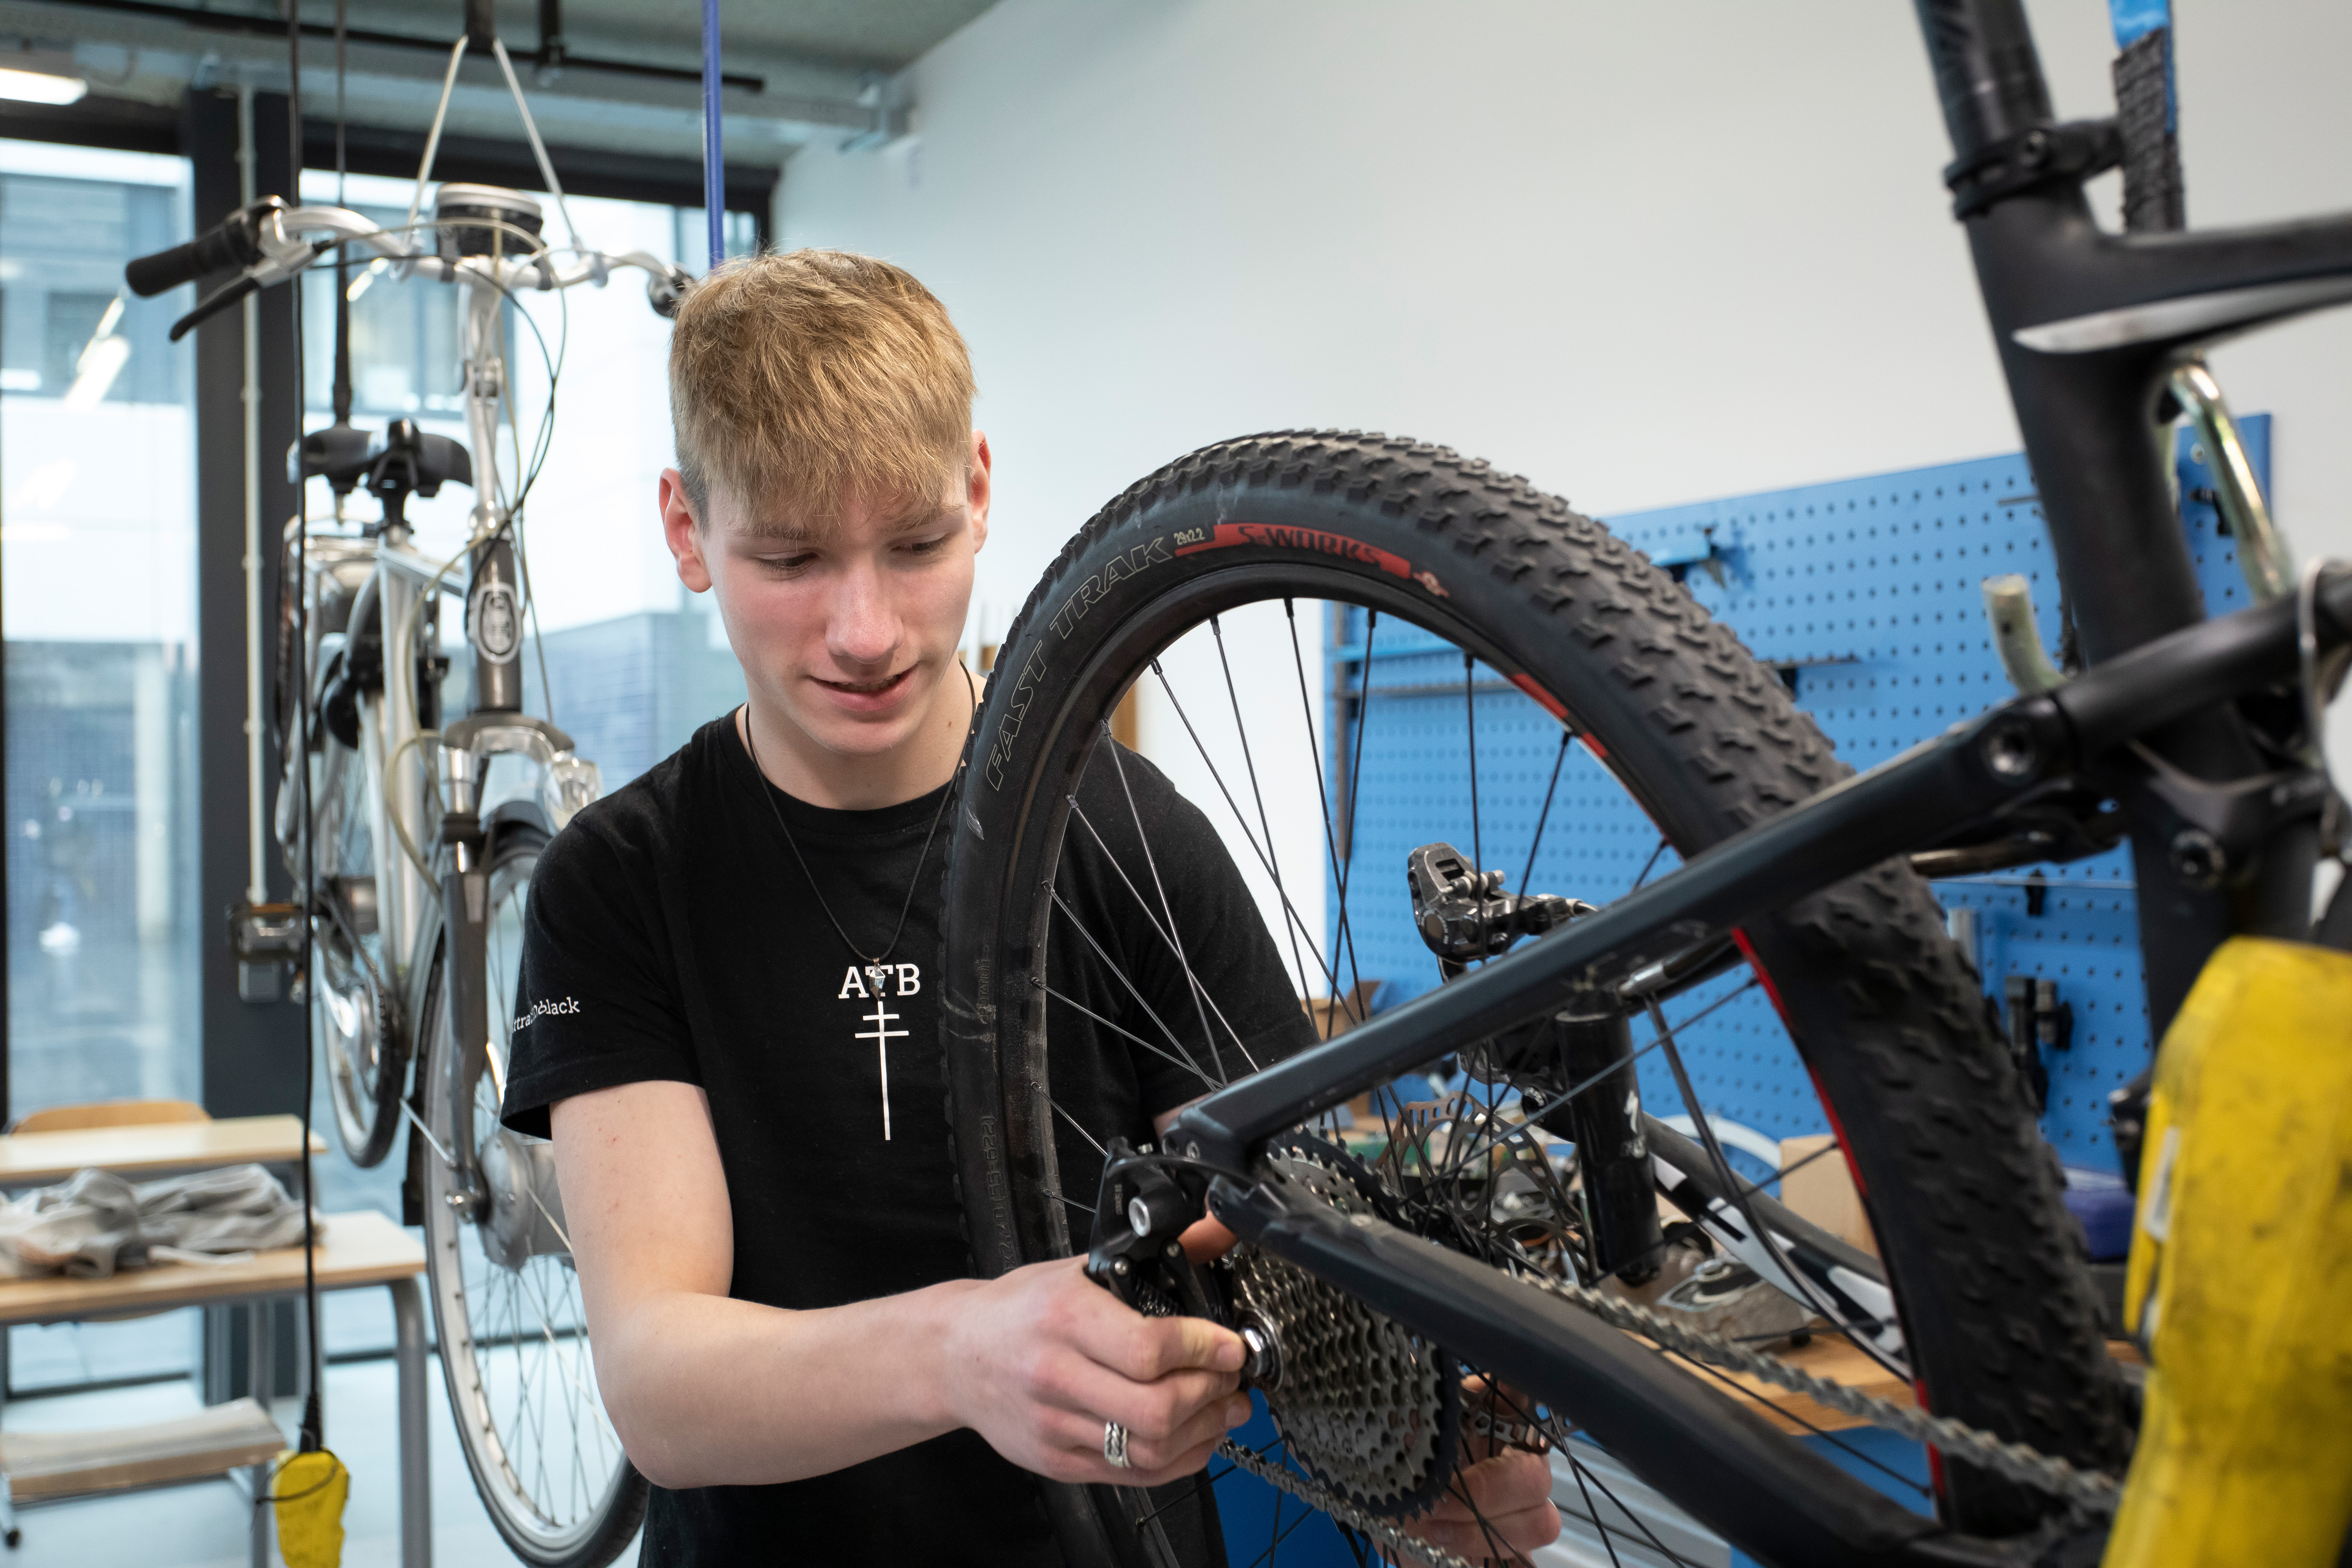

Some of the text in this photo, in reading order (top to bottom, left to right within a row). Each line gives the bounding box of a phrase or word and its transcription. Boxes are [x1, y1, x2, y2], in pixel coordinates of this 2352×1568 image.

[986, 536, 1173, 792] FAST TRAK
[838, 963, 921, 999] ATB
